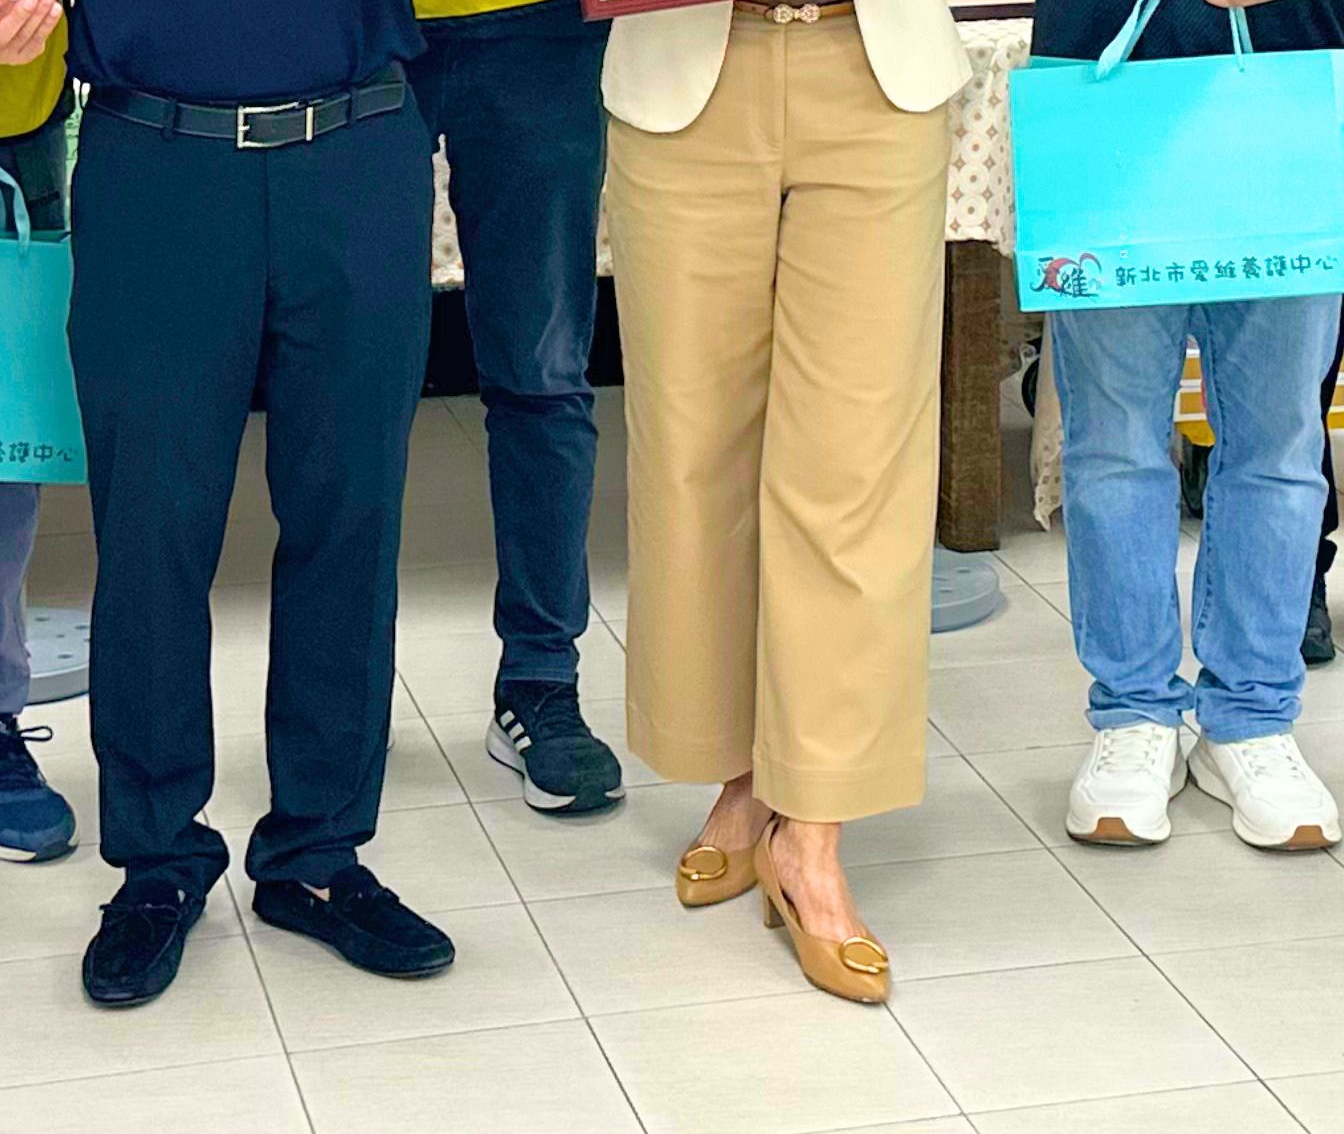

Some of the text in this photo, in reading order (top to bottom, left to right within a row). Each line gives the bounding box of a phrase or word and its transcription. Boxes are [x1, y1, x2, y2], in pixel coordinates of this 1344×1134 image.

[1115, 254, 1336, 287] 新北市愛維養護中心
